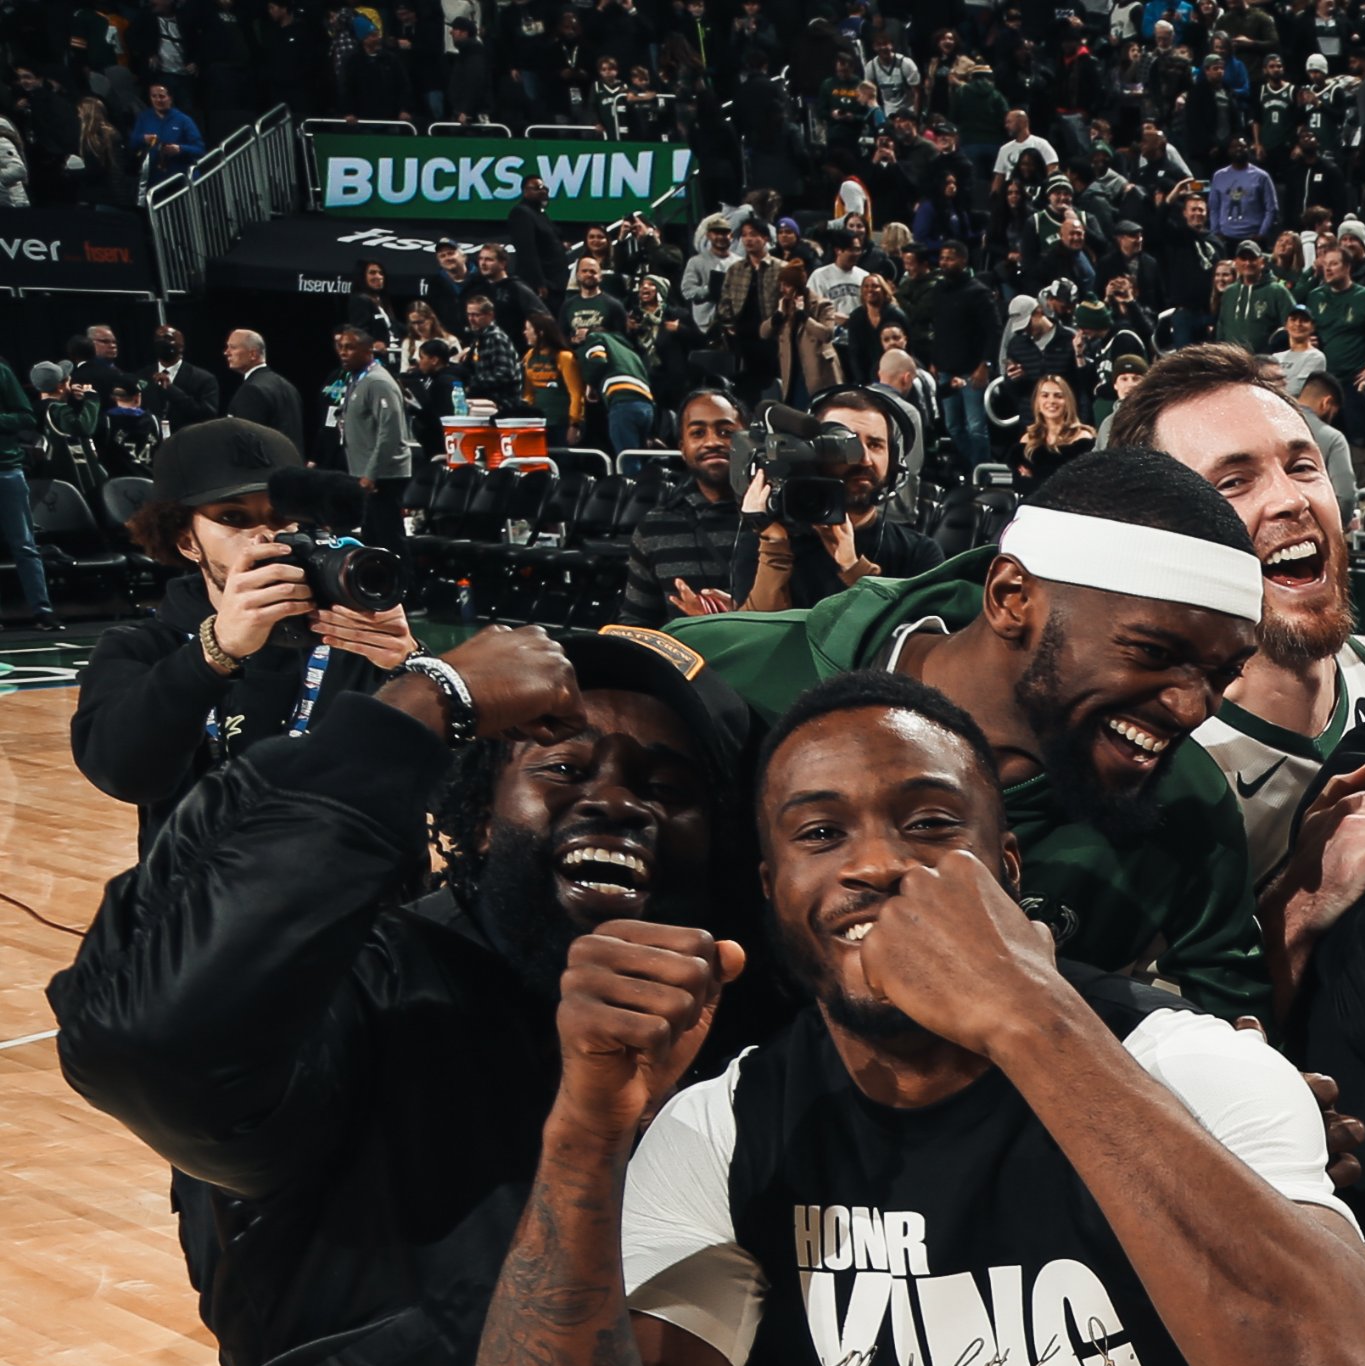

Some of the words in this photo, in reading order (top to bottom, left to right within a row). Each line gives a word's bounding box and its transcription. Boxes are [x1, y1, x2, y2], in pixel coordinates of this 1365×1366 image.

[324, 155, 525, 207] BUCKS
[537, 151, 654, 199] WIN
[672, 149, 692, 198] !
[794, 1204, 930, 1276] HONR
